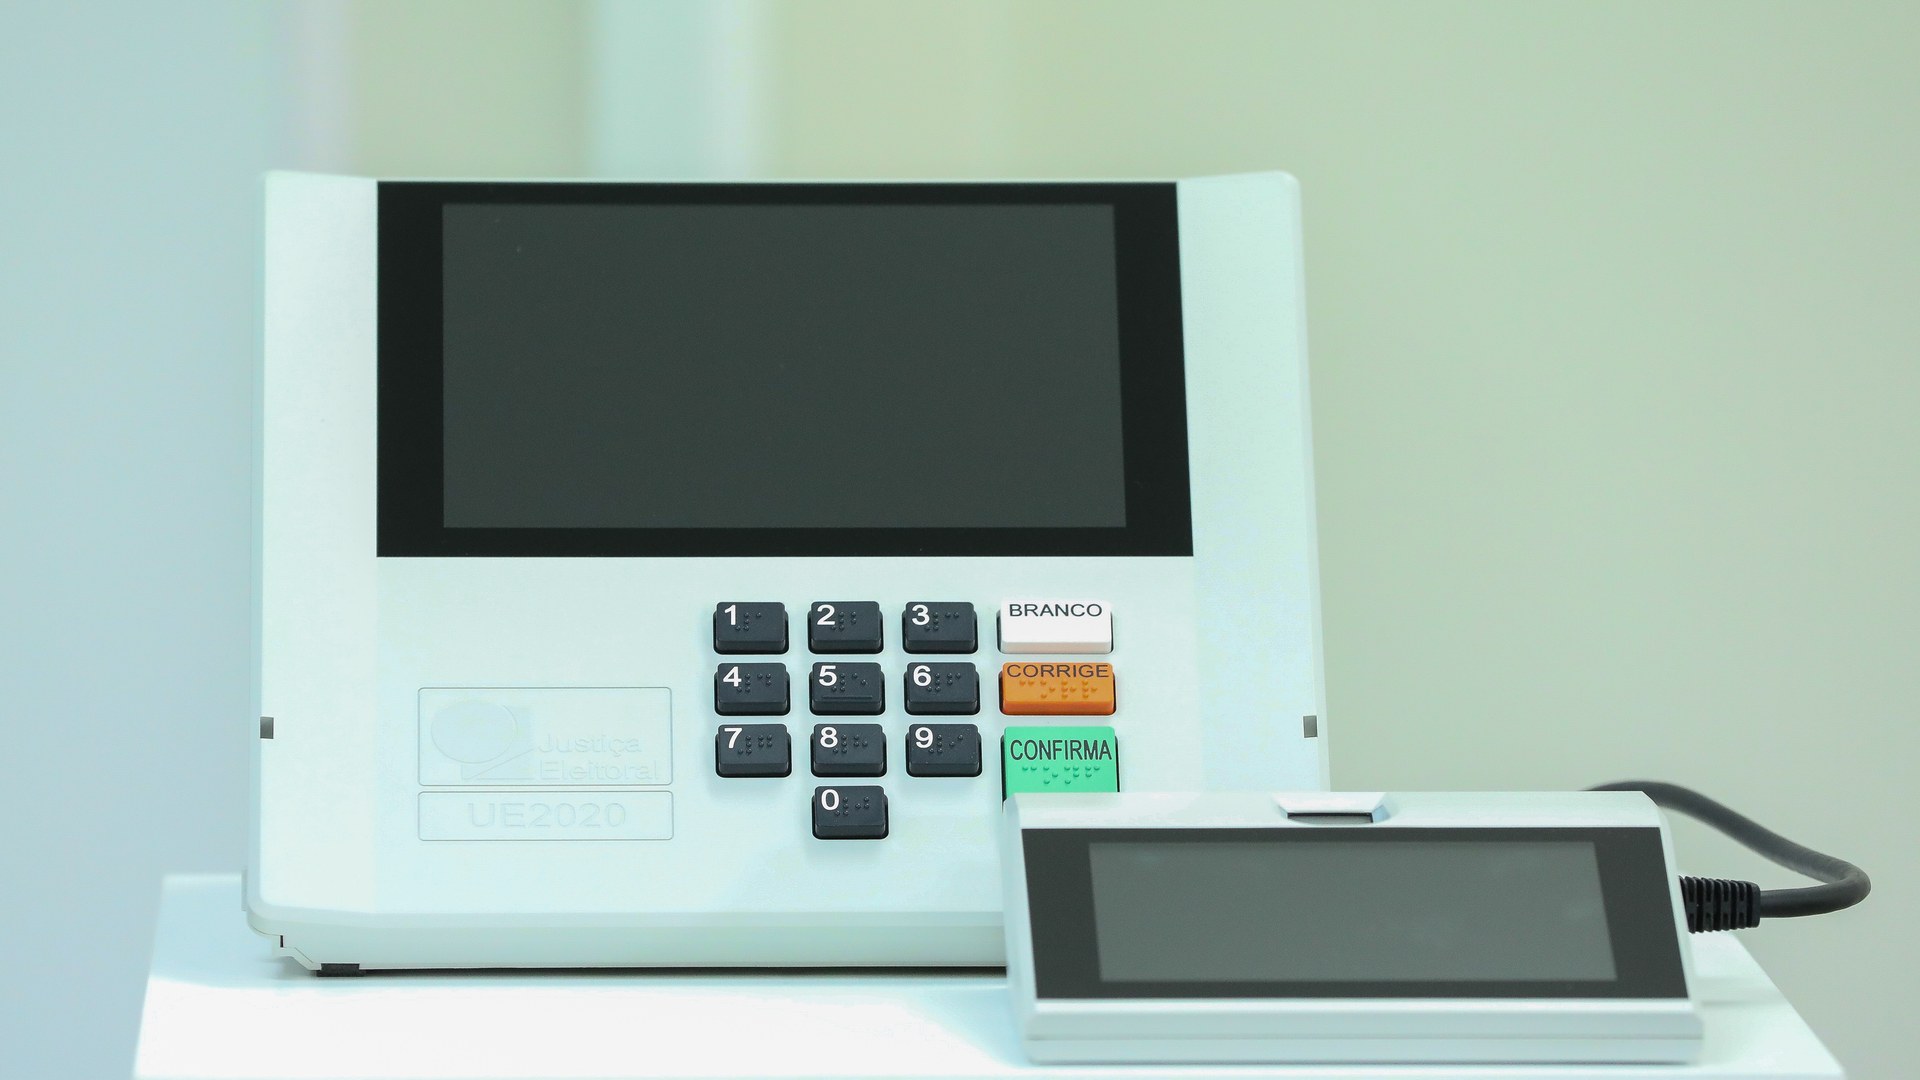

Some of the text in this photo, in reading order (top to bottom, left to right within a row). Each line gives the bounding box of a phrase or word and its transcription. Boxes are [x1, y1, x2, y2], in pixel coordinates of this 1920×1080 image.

[725, 605, 736, 625] 1
[817, 604, 835, 625] 2
[912, 605, 929, 625] 3
[1010, 604, 1102, 616] BRANCO
[723, 666, 742, 687] 4
[819, 665, 837, 686] 5
[914, 665, 931, 686] 6
[1007, 665, 1108, 677] CORRIGE
[538, 734, 641, 757] Justiça
[724, 728, 742, 748] 7
[820, 727, 838, 748] 8
[915, 727, 933, 748] 9
[1011, 740, 1112, 760] CONFIRMA
[539, 760, 658, 780] Eleitoral
[822, 789, 839, 810] 0
[468, 803, 626, 828] UE2020
